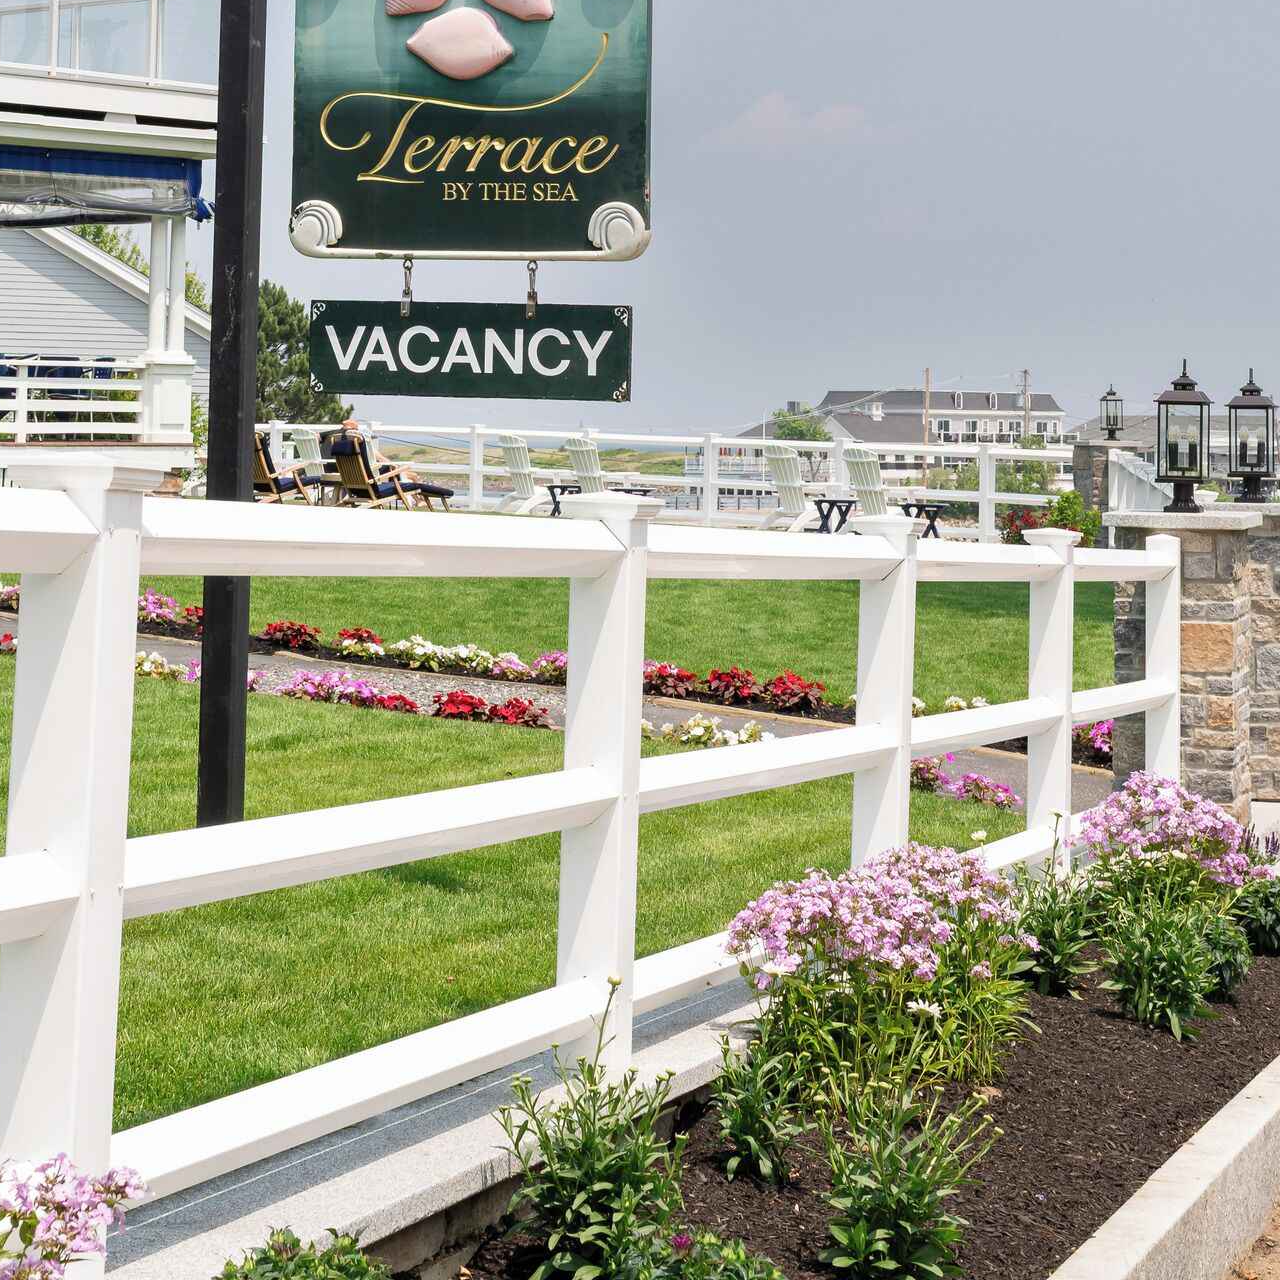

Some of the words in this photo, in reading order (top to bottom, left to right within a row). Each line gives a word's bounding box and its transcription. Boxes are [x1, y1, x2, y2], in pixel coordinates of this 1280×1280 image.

[320, 33, 619, 184] Terrace
[442, 182, 474, 201] BY
[479, 182, 527, 201] THE
[532, 182, 580, 202] SEA
[325, 325, 613, 377] VACANCY
